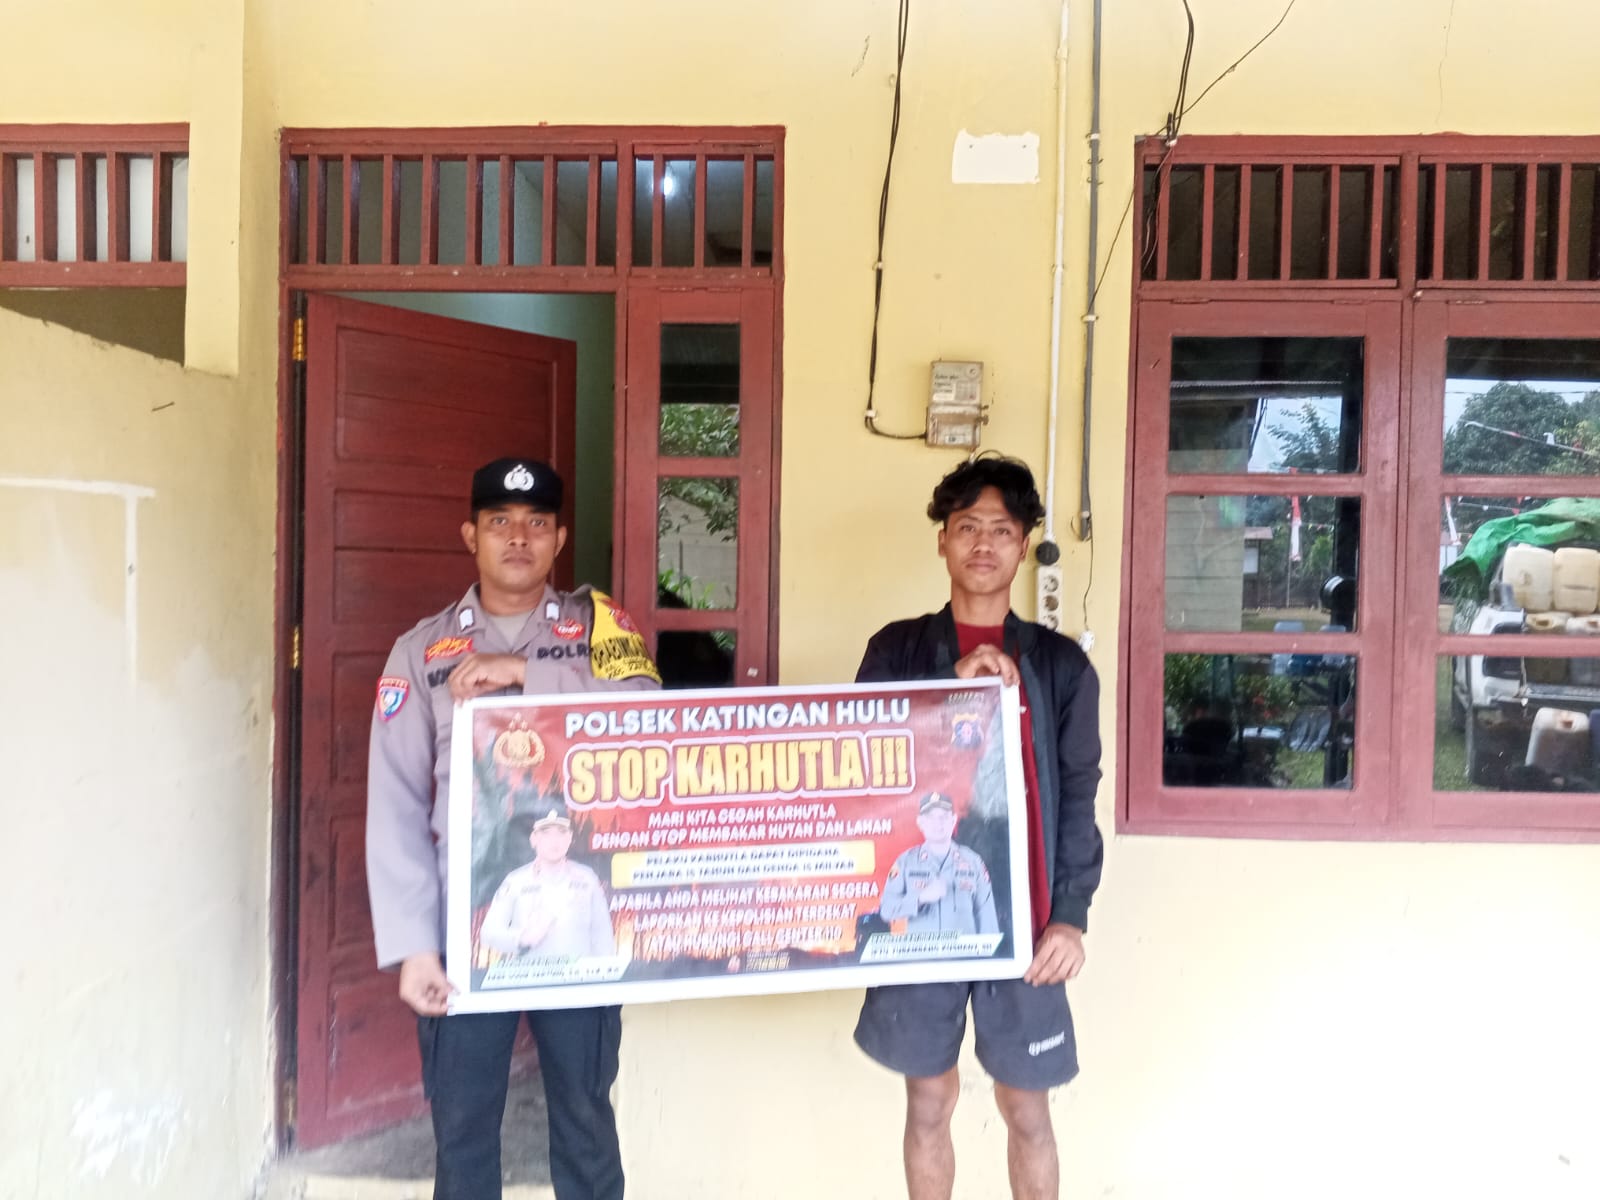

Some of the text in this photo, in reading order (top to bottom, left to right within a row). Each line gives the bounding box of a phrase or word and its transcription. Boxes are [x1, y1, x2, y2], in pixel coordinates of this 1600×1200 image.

[565, 698, 910, 739] POLSEK KATINGAN HULU
[569, 746, 669, 806] STOP
[675, 737, 865, 797] KARHUTLA
[648, 803, 837, 829] MARI KITA CEGAH KARHUTLA
[592, 818, 892, 850] DENGAN STOP MEMBAKAR HUTAN DAN LAHAN
[609, 881, 879, 913] APABILA ANDA MELIHAT KEBAKARAN SEGERA
[703, 909, 720, 927] KE
[720, 906, 793, 928] KEPOLISIAN
[794, 903, 857, 924] TERDEKAT
